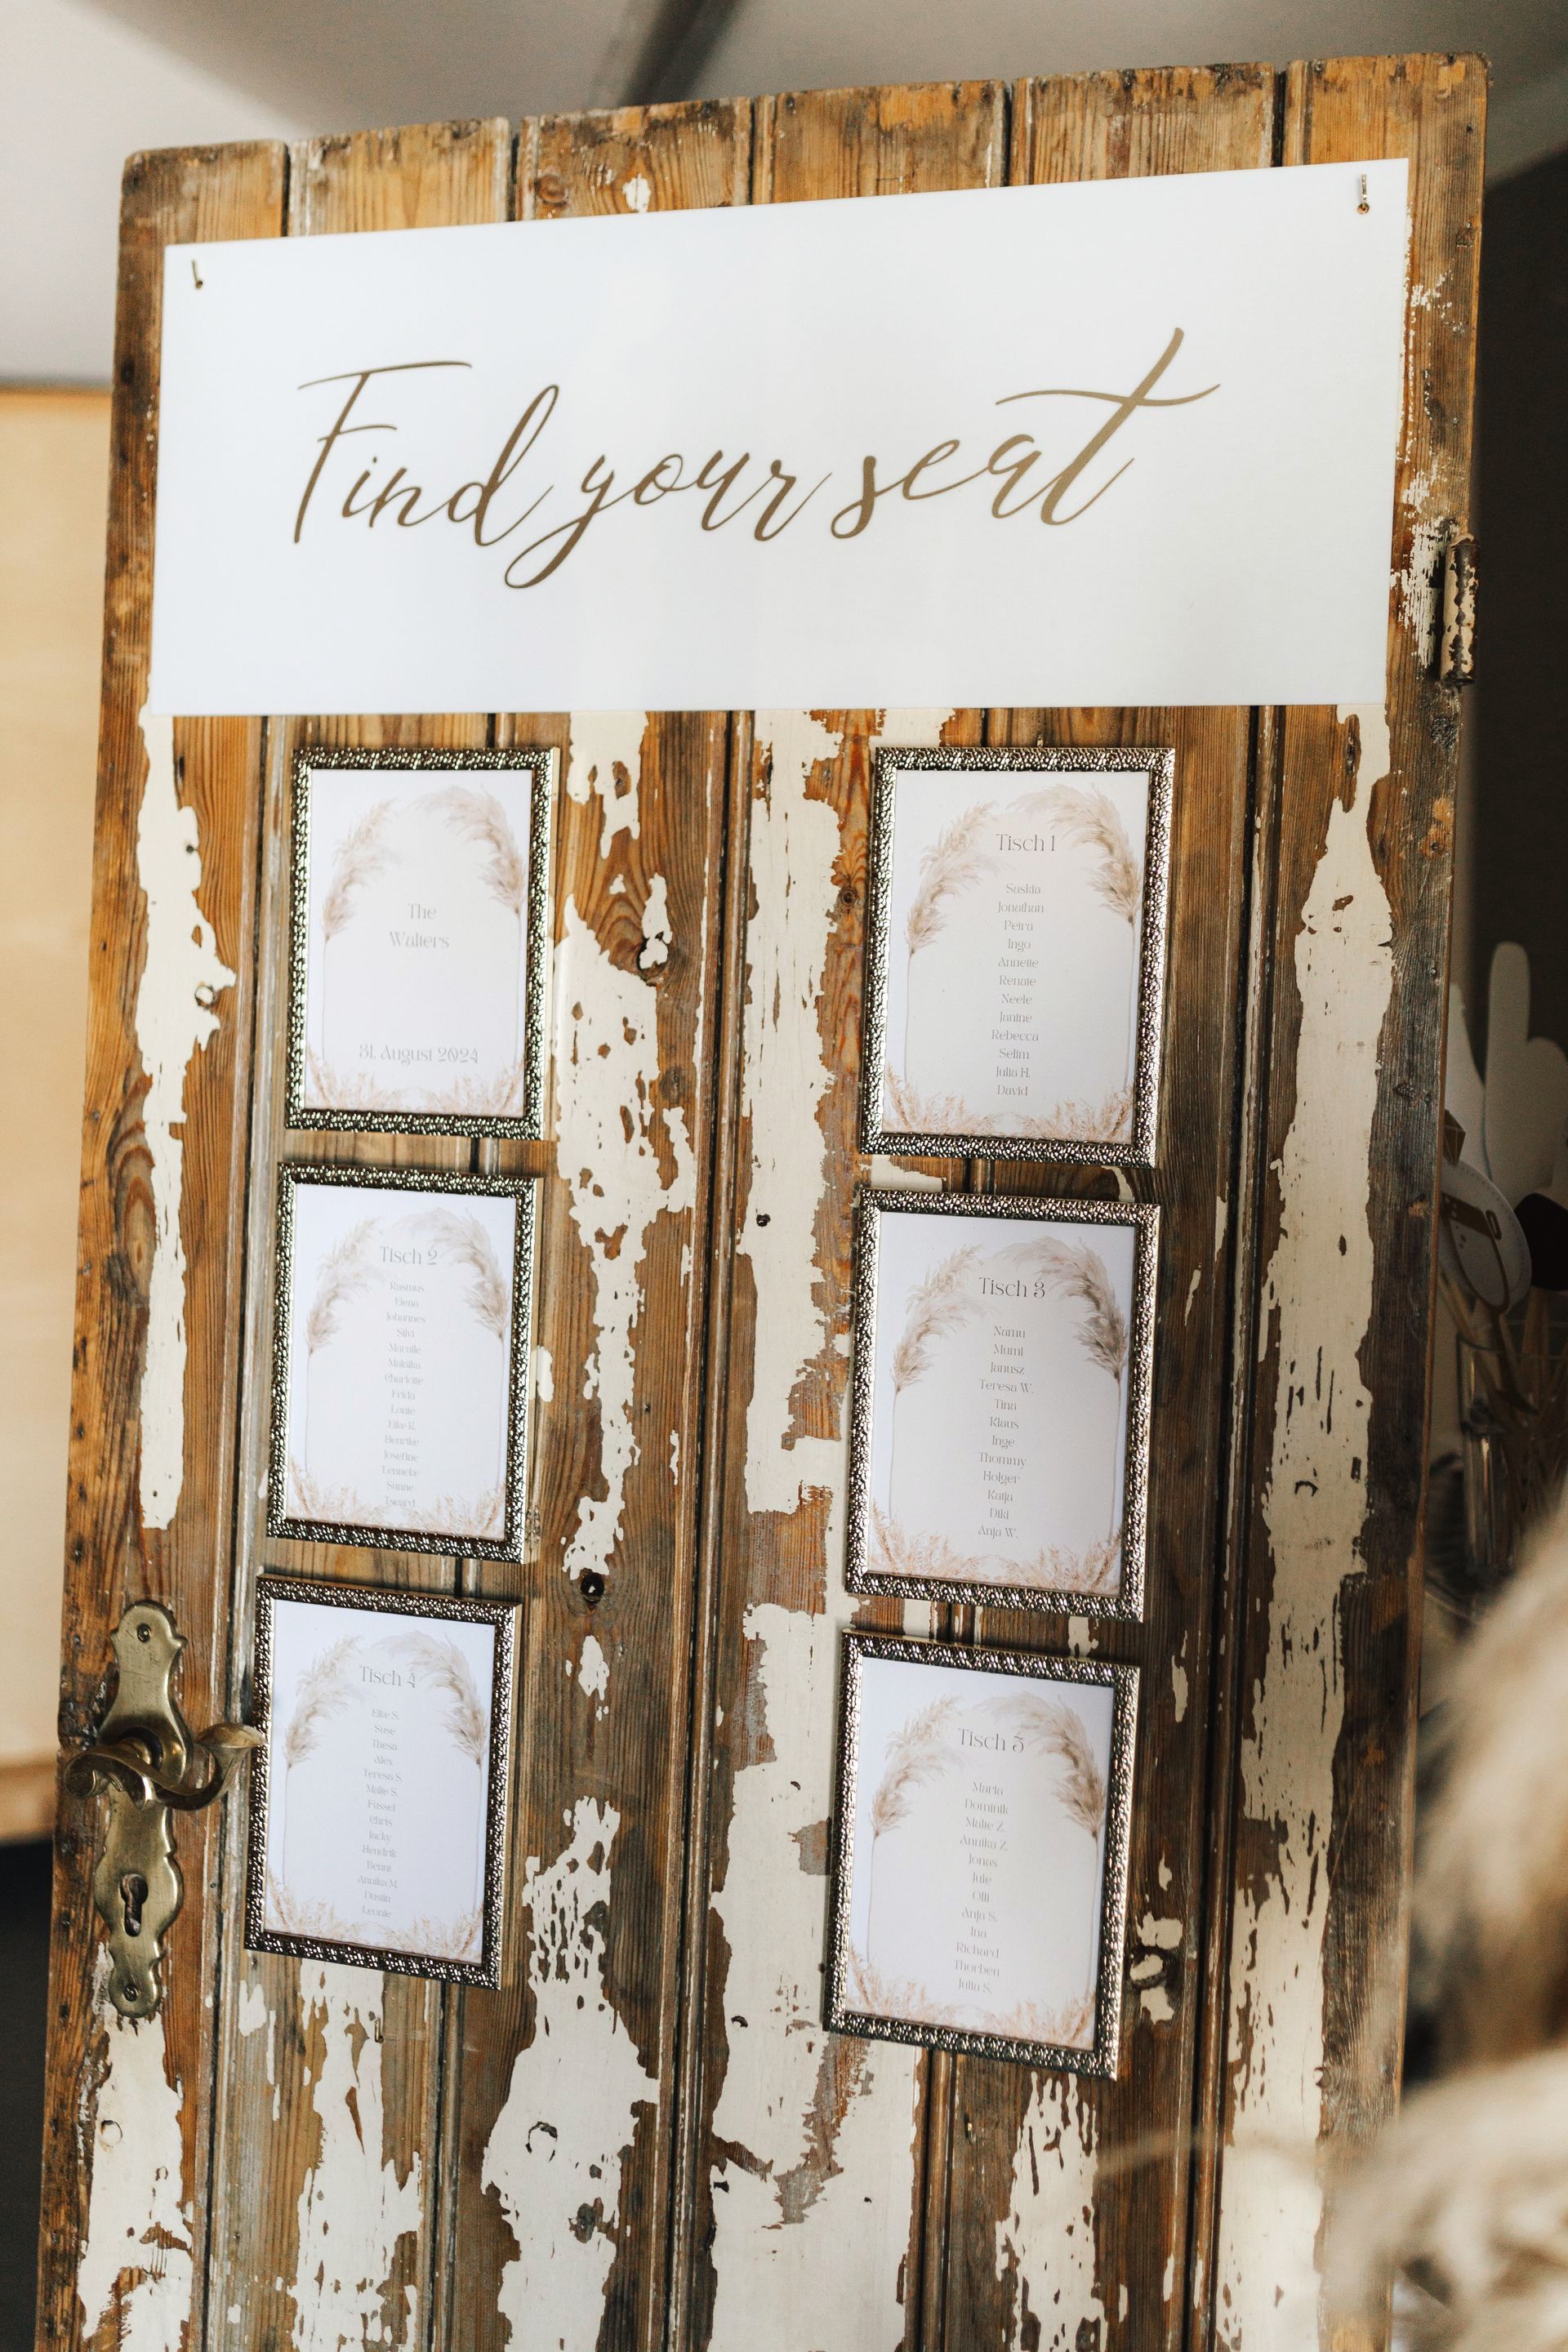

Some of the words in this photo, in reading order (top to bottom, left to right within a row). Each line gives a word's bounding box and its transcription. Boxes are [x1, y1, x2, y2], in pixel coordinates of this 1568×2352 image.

[294, 359, 558, 548] Find
[503, 448, 831, 589] your
[829, 326, 1221, 540] seat
[996, 833, 1045, 852] Tisch
[1049, 835, 1056, 852] 1
[1006, 883, 1040, 894] Saskia
[407, 902, 437, 920] The
[998, 902, 1045, 913] Jonathan
[1004, 920, 1033, 931] Petra
[390, 930, 450, 949] Walters
[1008, 938, 1031, 953] Ingo
[998, 956, 1039, 968] Annette
[999, 975, 1036, 987] Renate
[1001, 993, 1032, 1005] Neele
[1000, 1011, 1032, 1023] Janine
[991, 1029, 1039, 1041] Rebecca
[359, 1044, 376, 1059] 31.
[381, 1045, 432, 1066] August
[438, 1047, 478, 1063] 2024
[999, 1048, 1030, 1059] Selim
[996, 1066, 1018, 1078] Julia
[1021, 1067, 1031, 1078] H.
[997, 1085, 1028, 1096] David
[380, 1245, 422, 1265] Tisch
[427, 1249, 438, 1265] 2
[390, 1281, 425, 1293] Rasmus
[978, 1276, 1027, 1297] Tisch
[1034, 1281, 1046, 1298] 3
[394, 1297, 419, 1307] Elena
[386, 1312, 426, 1324] Johannes
[994, 1325, 1026, 1338] Namu
[994, 1344, 1023, 1356] Mumi
[991, 1361, 1025, 1374] Janusz
[384, 1374, 424, 1385] Charlotte
[980, 1379, 1017, 1392] Teresa
[1021, 1383, 1034, 1393] W.
[995, 1398, 1017, 1410] Tina
[990, 1416, 1019, 1428] Klaus
[385, 1435, 419, 1446] Henrike
[992, 1435, 1014, 1450] Inge
[384, 1450, 419, 1462] Josefine
[979, 1452, 1026, 1469] Thommy
[983, 1471, 1020, 1486] Holger
[987, 1490, 1013, 1503] Katja
[978, 1525, 1001, 1539] Anja
[1005, 1527, 1018, 1539] W.
[359, 1665, 401, 1686] Tisch
[407, 1673, 416, 1688] 4
[372, 1708, 390, 1719] Elke
[957, 1727, 1006, 1752] Tisch
[1012, 1735, 1025, 1753] 5
[374, 1755, 393, 1765] Alex
[363, 1768, 394, 1780] Teresa
[973, 1781, 1004, 1796] Maria
[964, 1798, 1009, 1815] Dominik
[369, 1815, 393, 1826] Chris
[965, 1816, 993, 1830] Malte
[960, 1834, 996, 1849] Annika
[362, 1845, 398, 1859] Hendrik
[969, 1853, 998, 1867] Jonas
[973, 1871, 991, 1884] Jule
[972, 1891, 990, 1903] Olli
[962, 1907, 986, 1922] Anja
[970, 1927, 987, 1938] Ina
[956, 1941, 1000, 1958] Richard
[954, 1959, 1000, 1977] Thorben
[959, 1978, 980, 1992] Julia
